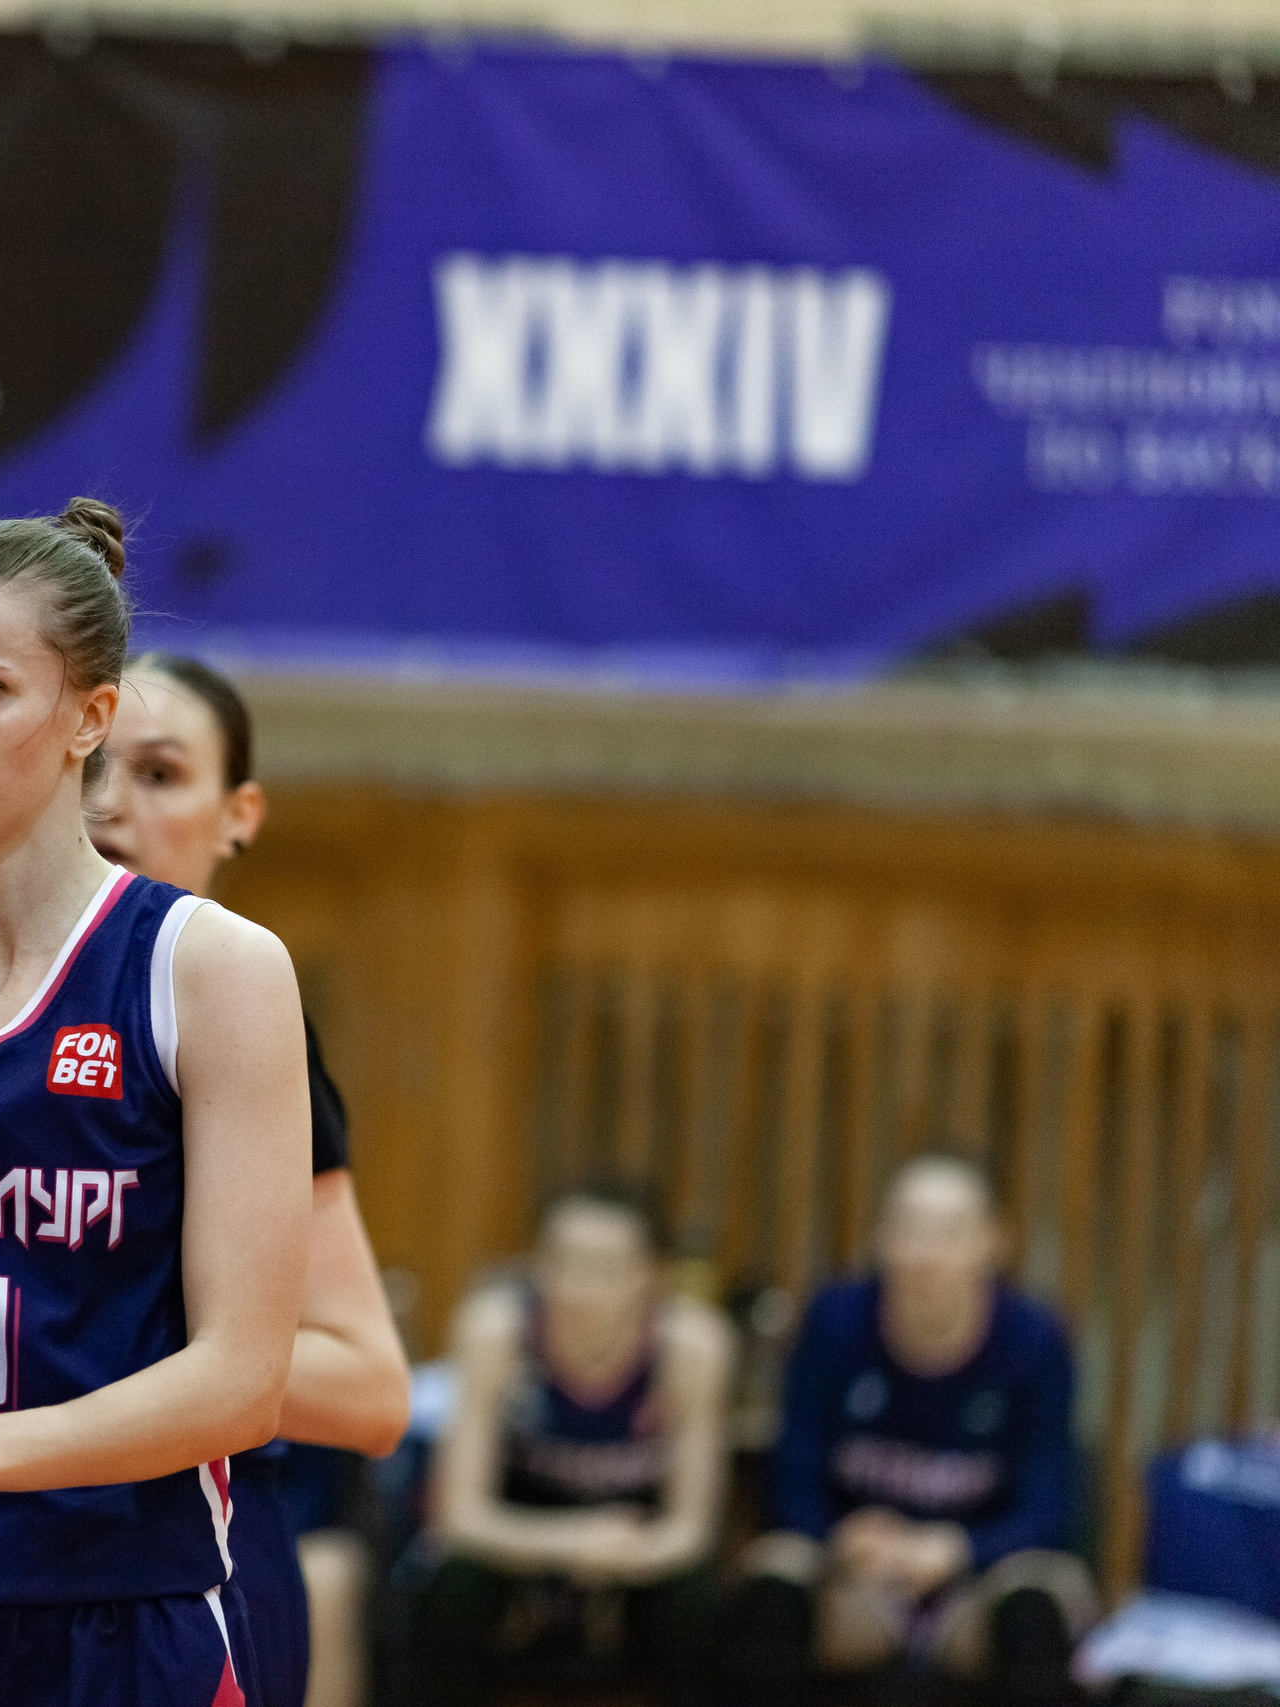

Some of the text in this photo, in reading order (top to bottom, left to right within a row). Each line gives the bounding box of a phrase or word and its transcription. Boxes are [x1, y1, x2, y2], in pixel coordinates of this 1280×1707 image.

[430, 254, 888, 484] XXXIV
[56, 1032, 116, 1061] FON
[52, 1058, 117, 1088] BET
